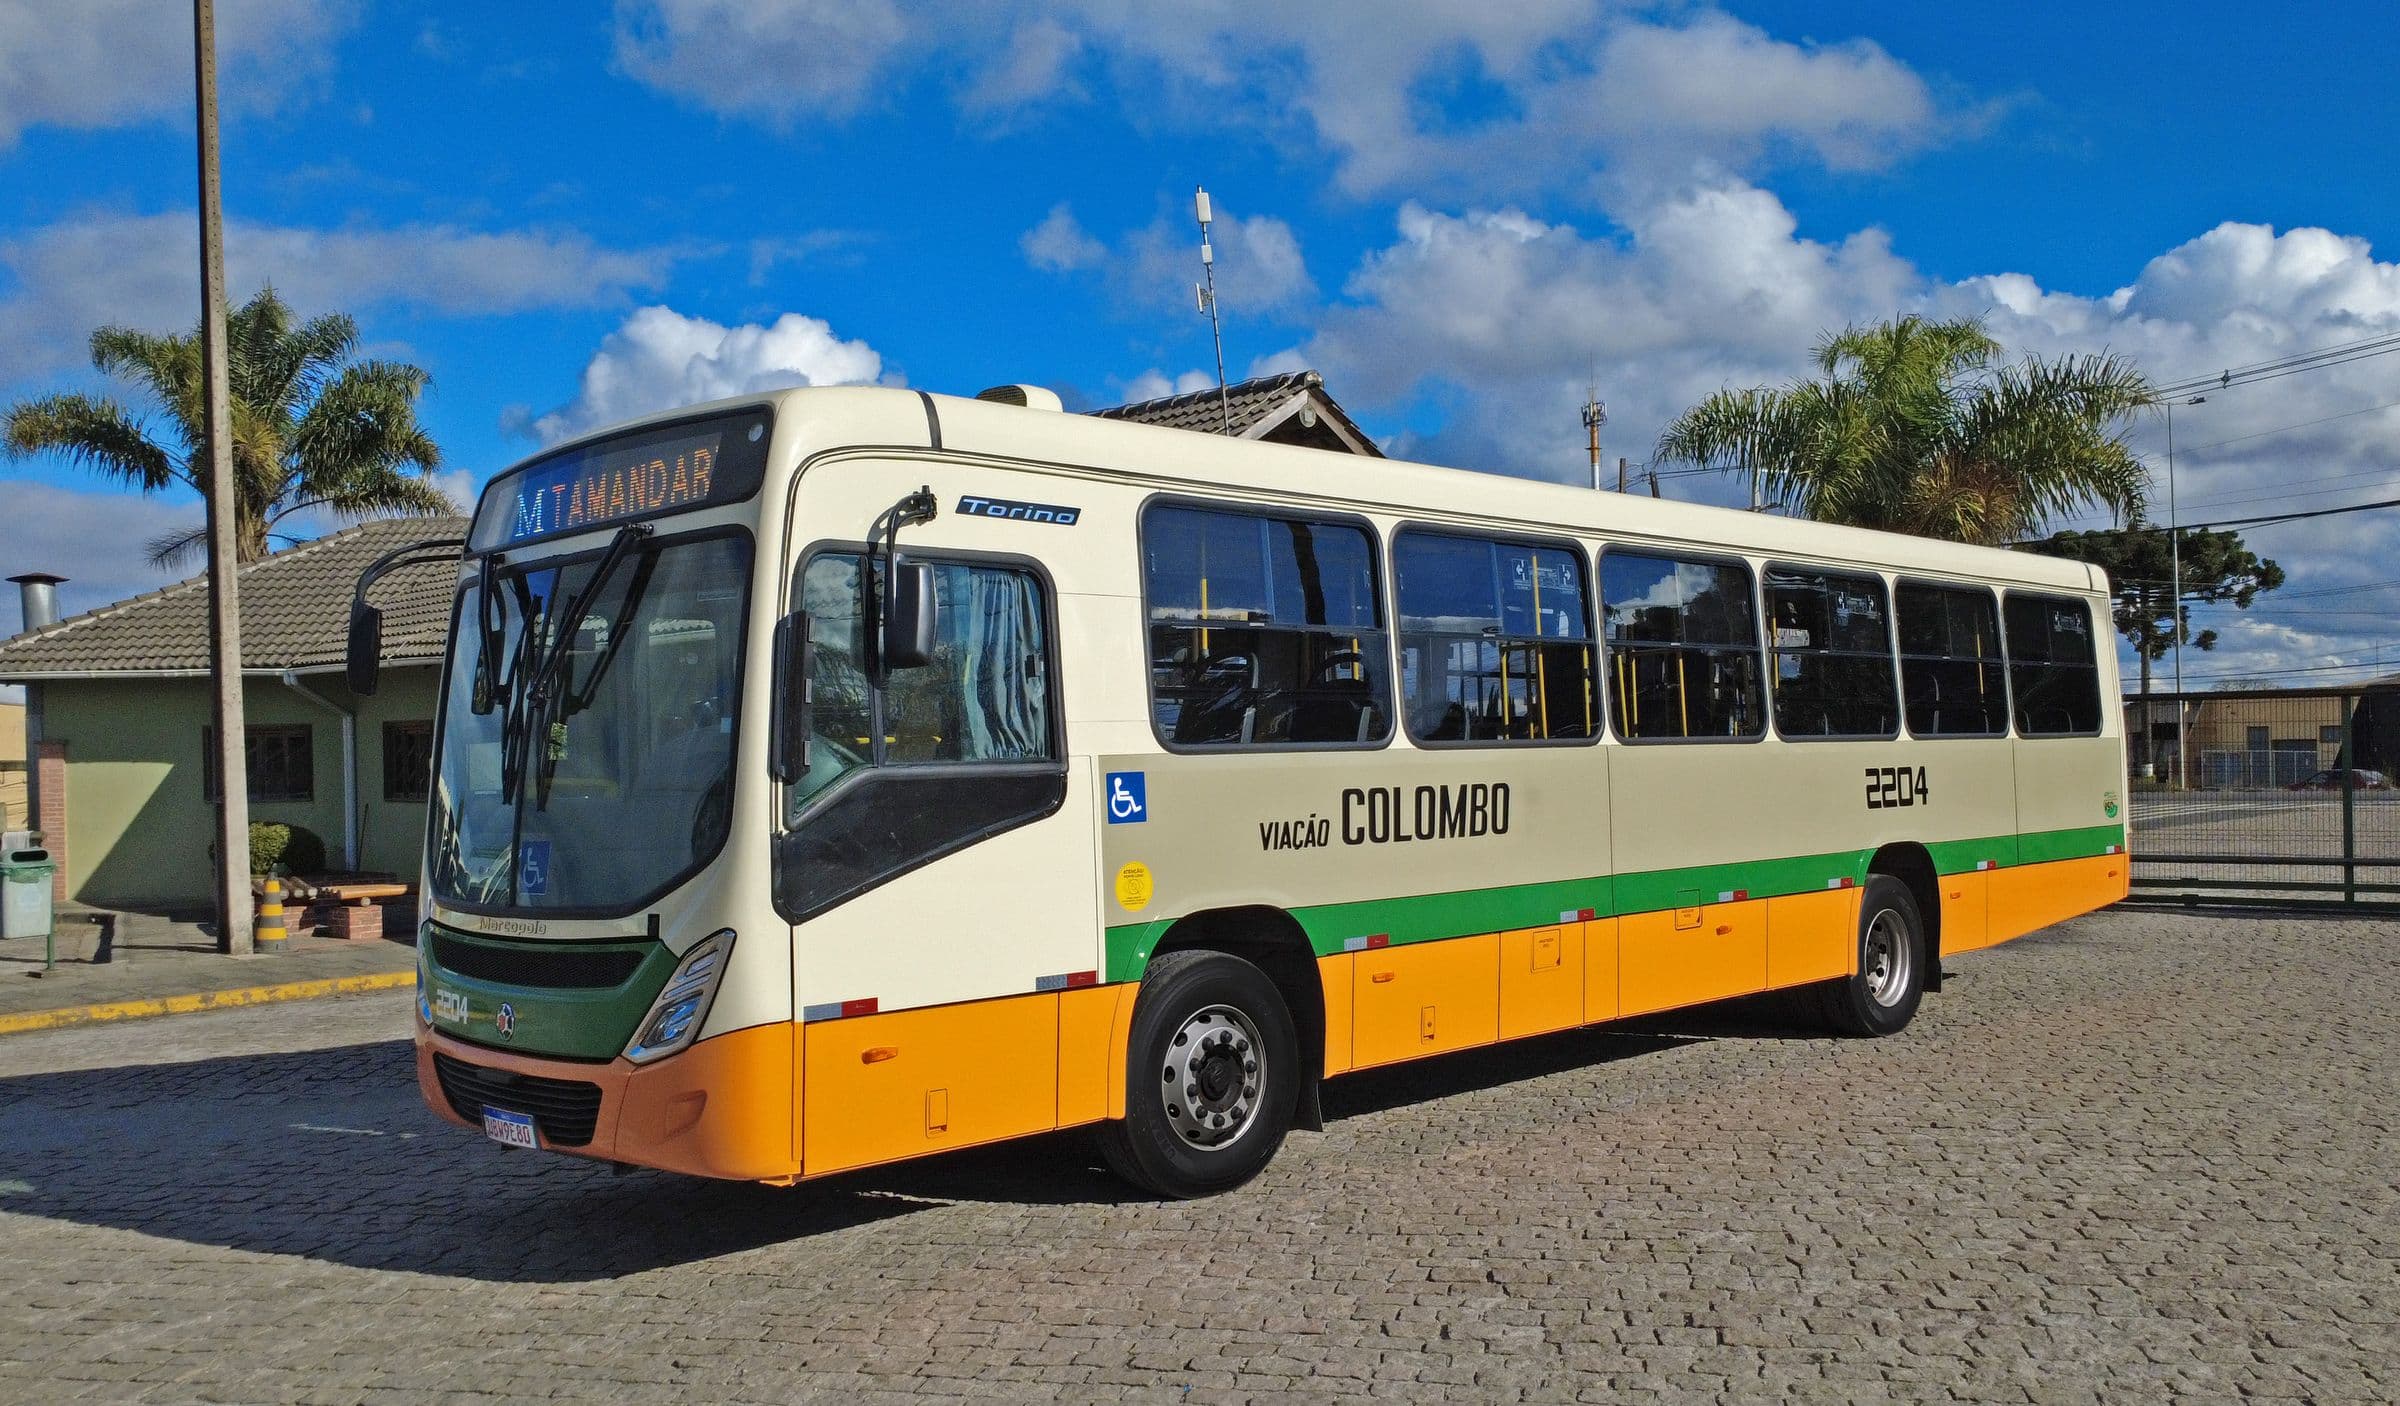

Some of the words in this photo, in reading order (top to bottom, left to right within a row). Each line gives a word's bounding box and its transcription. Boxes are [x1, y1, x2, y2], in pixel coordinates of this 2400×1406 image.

[515, 488, 546, 537] M
[552, 446, 719, 529] TAMANDAR
[962, 499, 1075, 523] Torino
[1865, 766, 1928, 809] 2204
[1341, 783, 1509, 845] COLOMBO
[480, 917, 547, 935] Marcopolo
[436, 988, 469, 1025] 2204
